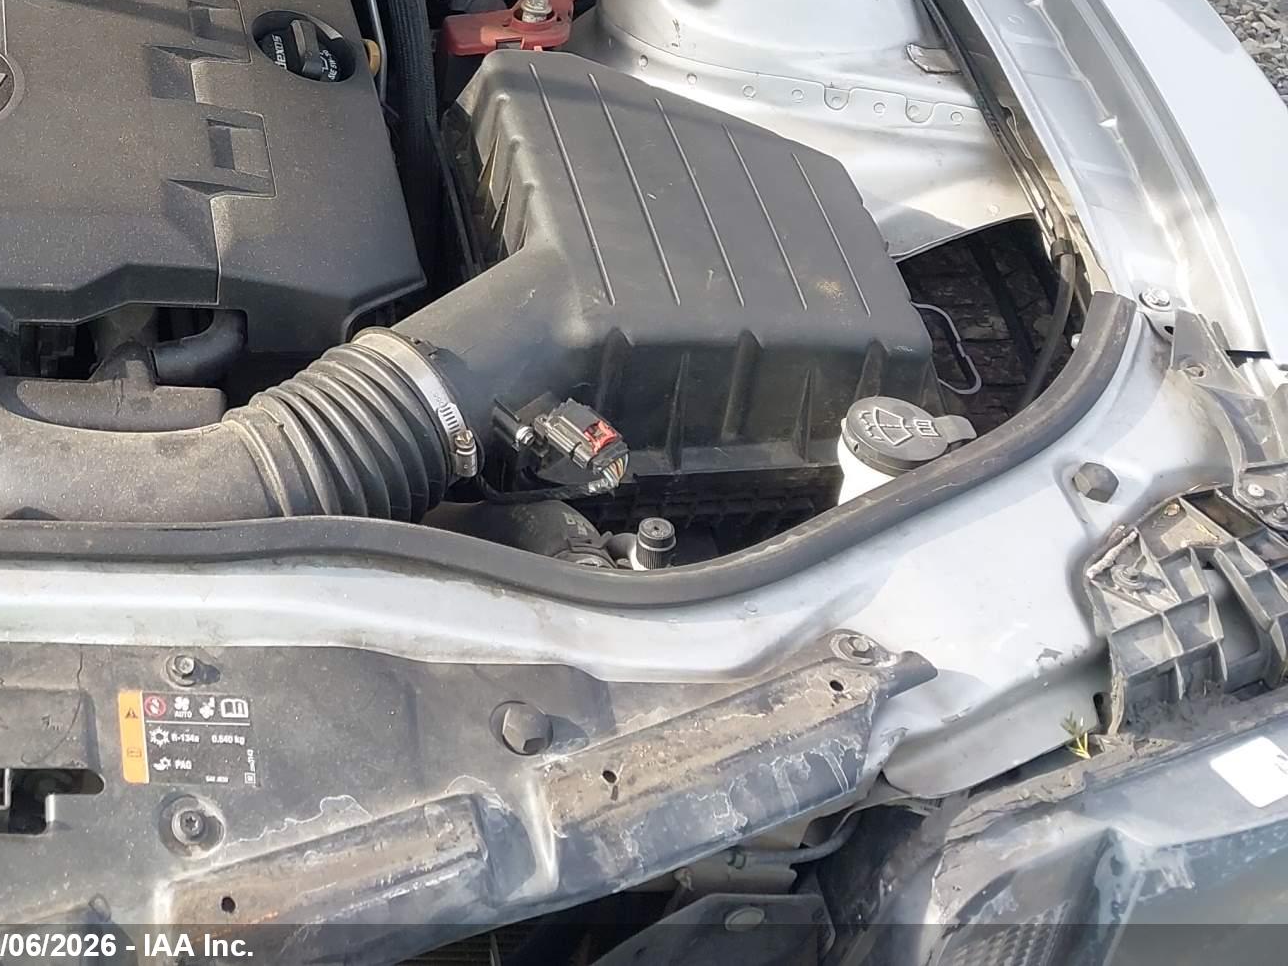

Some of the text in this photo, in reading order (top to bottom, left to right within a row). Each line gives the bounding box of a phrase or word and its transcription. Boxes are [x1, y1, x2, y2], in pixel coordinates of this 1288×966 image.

[171, 733, 200, 743] R-134a
[234, 735, 246, 746] kg
[174, 760, 192, 770] PAG
